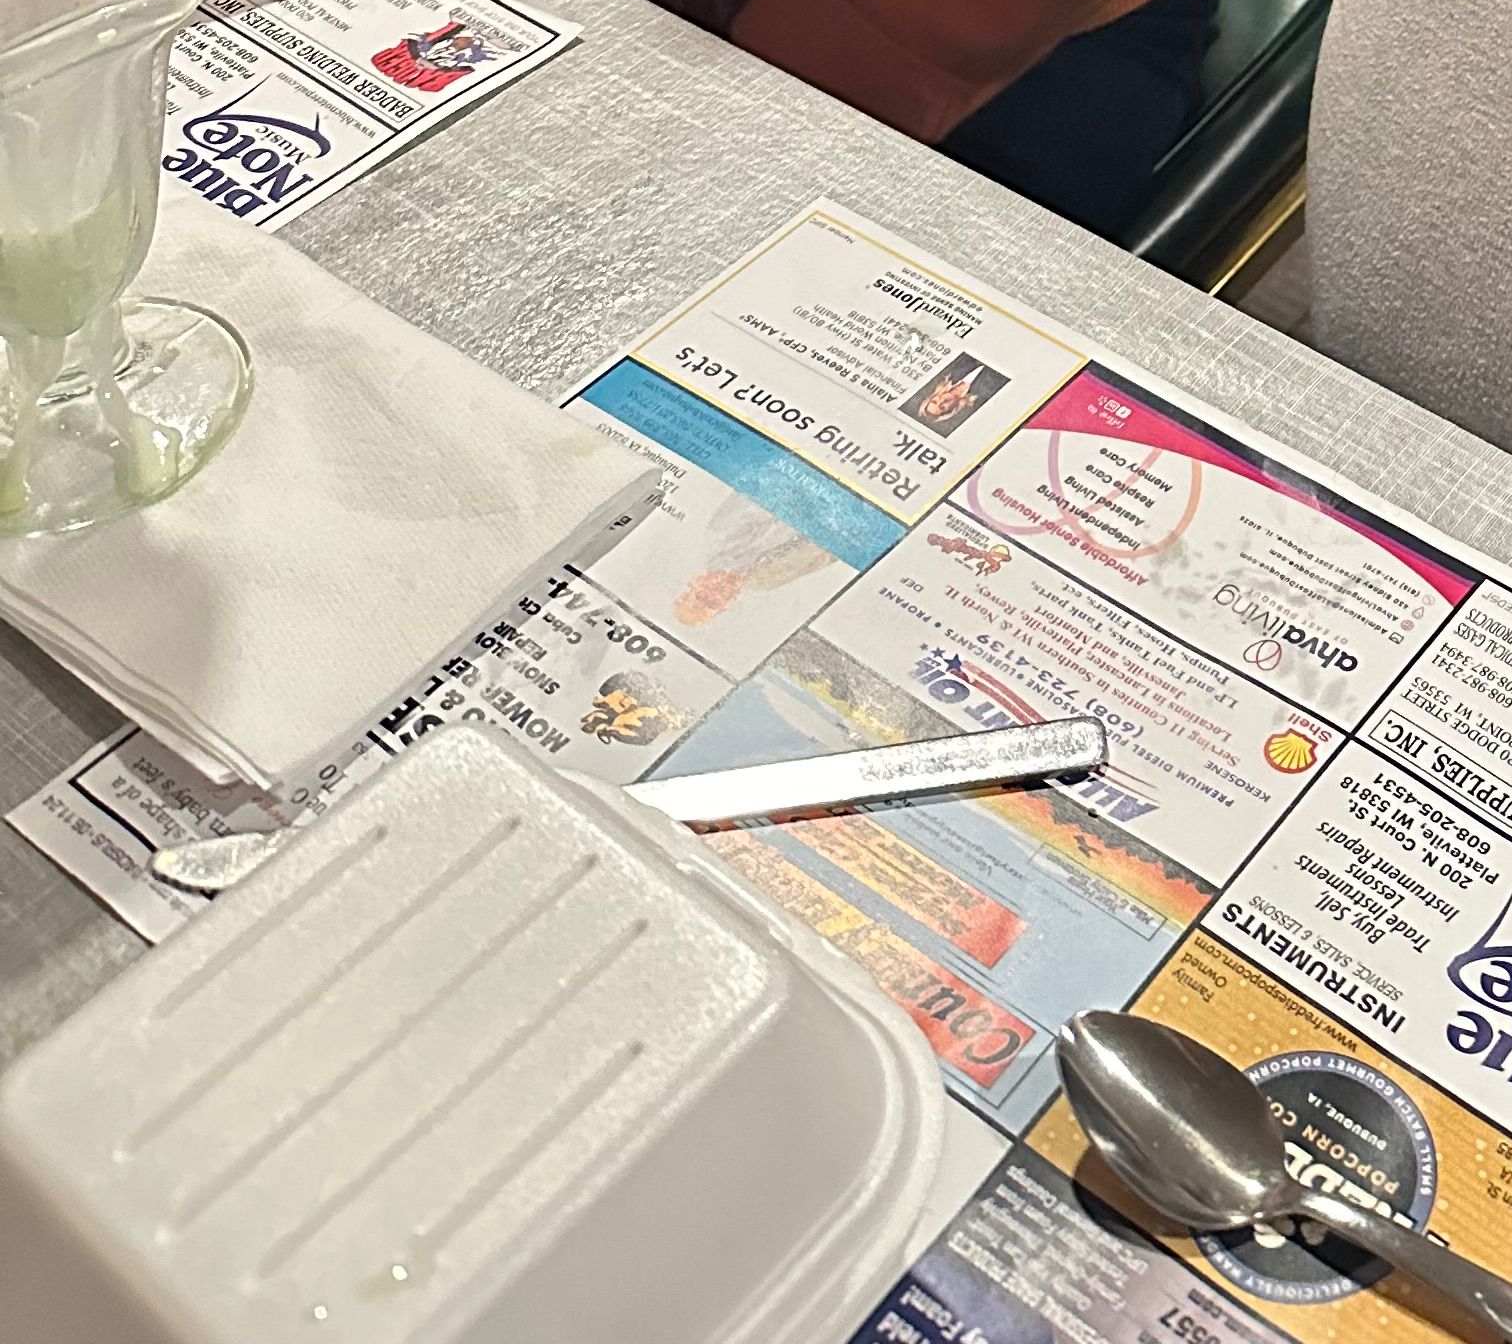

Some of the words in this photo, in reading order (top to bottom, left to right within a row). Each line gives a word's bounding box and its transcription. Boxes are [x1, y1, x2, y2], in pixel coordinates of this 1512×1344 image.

[239, 6, 303, 49] SUPPLIES,
[174, 42, 203, 62] Court
[296, 45, 359, 85] WELDING
[371, 38, 474, 95] BADGER
[353, 79, 414, 118] BADGER
[191, 116, 312, 202] Note
[255, 125, 311, 165] Music
[901, 267, 982, 312] edwardjones.com
[813, 303, 844, 324] Health
[842, 320, 873, 340] World
[675, 346, 738, 389] Let's
[809, 349, 851, 377] Reeves,
[825, 345, 864, 368] Advisor
[861, 343, 892, 364] Water
[860, 378, 897, 403] Alaina
[861, 365, 907, 393] Financial
[733, 384, 815, 432] soon?
[813, 424, 920, 501] Retiring
[886, 429, 946, 474] talk.
[1099, 447, 1126, 467] Care
[1063, 475, 1097, 500] Living
[1084, 464, 1112, 484] Care
[1125, 462, 1173, 492] Memory
[991, 487, 1041, 523] Housing
[1036, 484, 1070, 509] Living
[1094, 495, 1144, 526] Assisted
[1112, 480, 1155, 508] Respite
[1039, 519, 1080, 546] Senior
[1068, 504, 1140, 551] Independent
[1079, 541, 1148, 586] Affordable
[878, 586, 931, 622] PROPANE
[960, 595, 998, 624] North
[974, 583, 1017, 615] Rewey,
[541, 611, 582, 644] Cuba
[1011, 627, 1034, 646] WI
[1033, 605, 1092, 644] Montfort
[1068, 605, 1103, 632] Tank
[1453, 622, 1486, 647] GASES
[944, 628, 1016, 675] LUBRICANTS
[976, 634, 1079, 700] 723-4139
[1036, 641, 1094, 682] Southern
[1090, 640, 1119, 660] and
[1152, 657, 1185, 680] Fuel
[907, 659, 970, 706] OIL
[1085, 650, 1150, 696] Lancaster,
[1185, 675, 1215, 695] and
[1410, 676, 1451, 705] 53565
[1085, 697, 1144, 738] (608)
[1111, 687, 1168, 726] Counties
[1167, 701, 1232, 742] Locations
[1399, 688, 1452, 723] STREET
[1287, 712, 1332, 742] Shell
[1379, 719, 1428, 758] INC.
[1450, 718, 1500, 754] DODGE
[1132, 743, 1173, 772] DIESEL
[1186, 729, 1240, 767] Serving
[130, 756, 164, 783] feet
[1175, 769, 1234, 807] PREMIUM
[1204, 760, 1271, 802] KEROSENE
[158, 778, 211, 824] baby's
[1339, 776, 1390, 812] 53818
[1343, 798, 1369, 819] St.
[138, 797, 186, 839] shape
[1373, 773, 1490, 854] 608-205-4531
[1390, 808, 1414, 830] WI
[1315, 821, 1375, 864] Repairs
[1370, 814, 1416, 851] Court
[1418, 847, 1439, 867] N.
[1294, 854, 1388, 921] Instruments
[1344, 863, 1405, 908] Lessons
[1370, 857, 1459, 922] Instrument
[1439, 863, 1473, 889] 200
[1248, 895, 1303, 934] LESSONS
[1314, 890, 1351, 921] Sell,
[1349, 912, 1386, 944] Buy,
[1385, 913, 1430, 953] Trade
[1180, 951, 1227, 988] Owned
[1222, 903, 1404, 1032] INSTRUMENTS
[1312, 935, 1352, 967] SALES,
[1171, 967, 1214, 1003] Family
[1194, 936, 1357, 1052] www.freddiespopcorn.com
[1351, 961, 1403, 1001] SERVICE,
[1248, 1055, 1320, 1080] POPCORN
[1327, 1057, 1394, 1096] GOURMET
[1326, 1103, 1387, 1151] DUBUQUE,
[1393, 1096, 1424, 1139] BATCH
[1302, 1124, 1399, 1194] POPCORN
